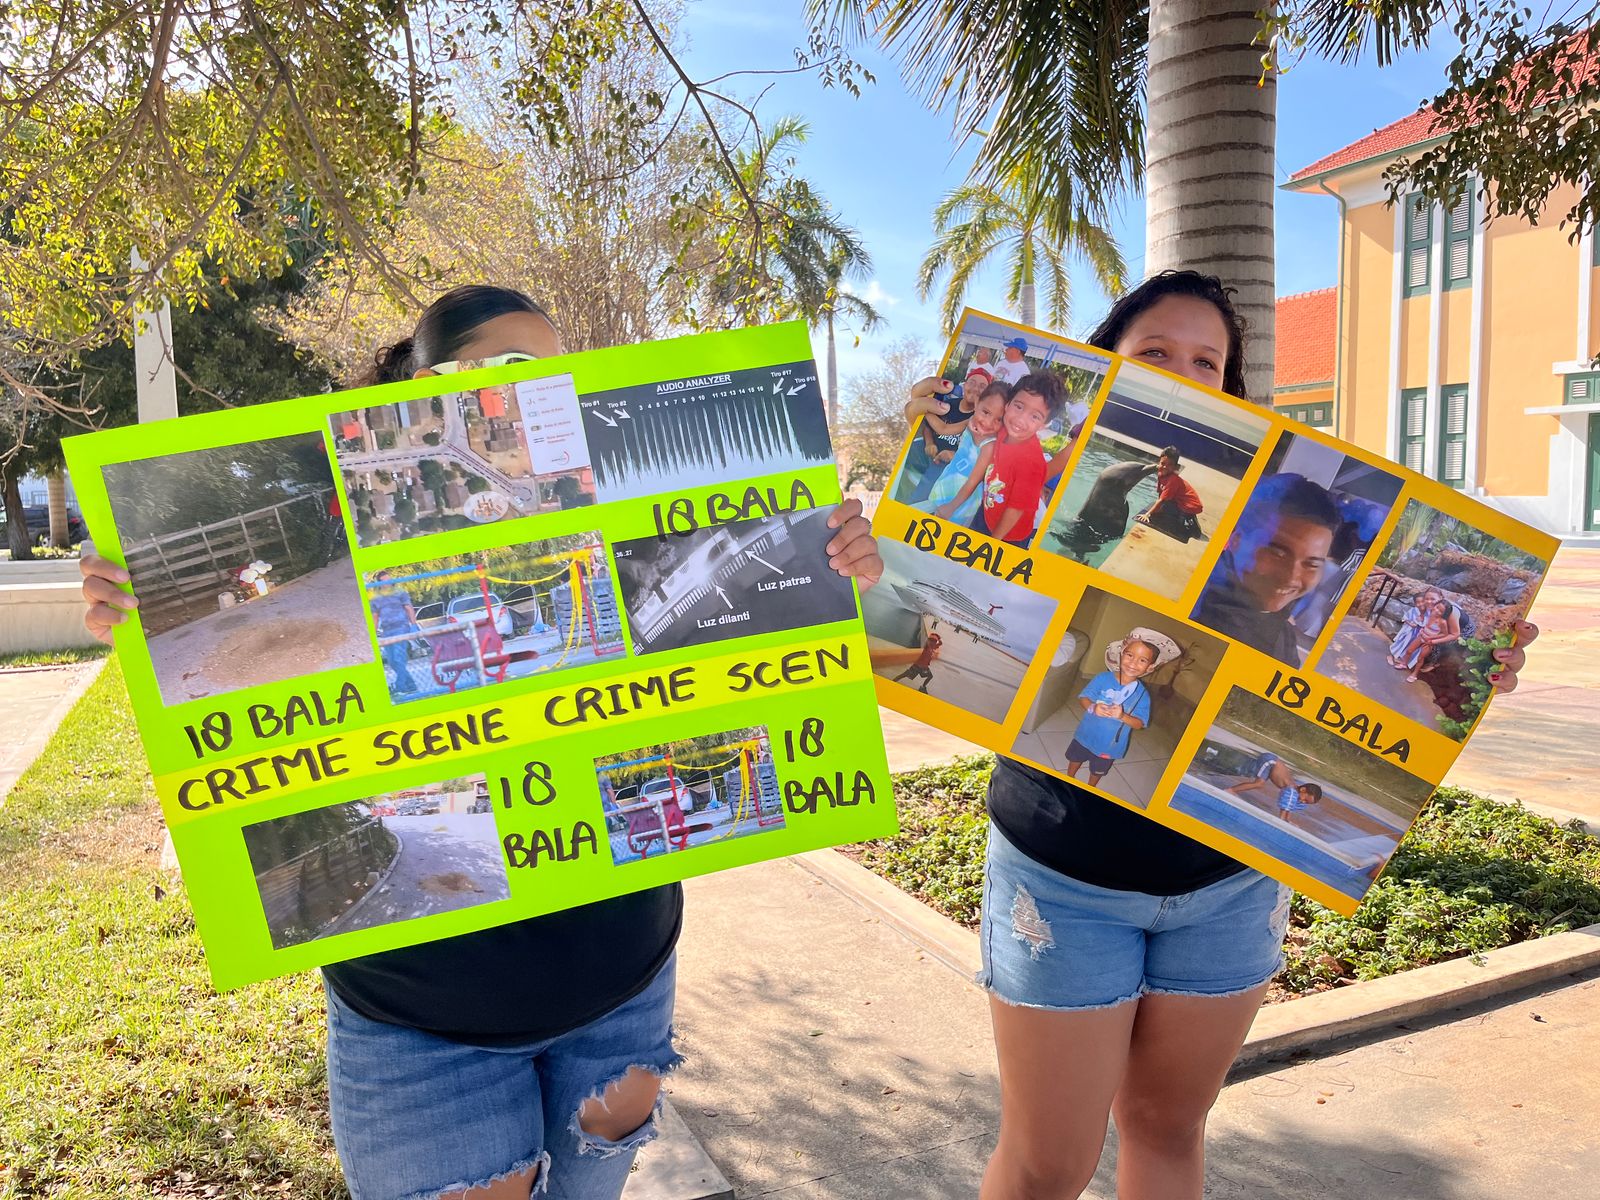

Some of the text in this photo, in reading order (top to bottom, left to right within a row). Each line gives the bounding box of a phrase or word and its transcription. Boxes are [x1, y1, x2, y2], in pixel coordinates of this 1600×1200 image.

[656, 374, 732, 393] AUDIO ANALYZER
[653, 478, 816, 543] 18 BALA
[904, 518, 1034, 585] 18 BALA
[757, 574, 812, 592] Luz patras
[697, 611, 750, 629] Luz dilanti
[178, 643, 850, 812] CRIME SCENE CRIME SCEN
[184, 681, 365, 759] 18 BALA
[784, 717, 825, 763] 18
[1264, 670, 1411, 764] 18 BALA
[500, 761, 557, 809] 18
[784, 770, 876, 814] BALA
[503, 821, 598, 869] BALA
